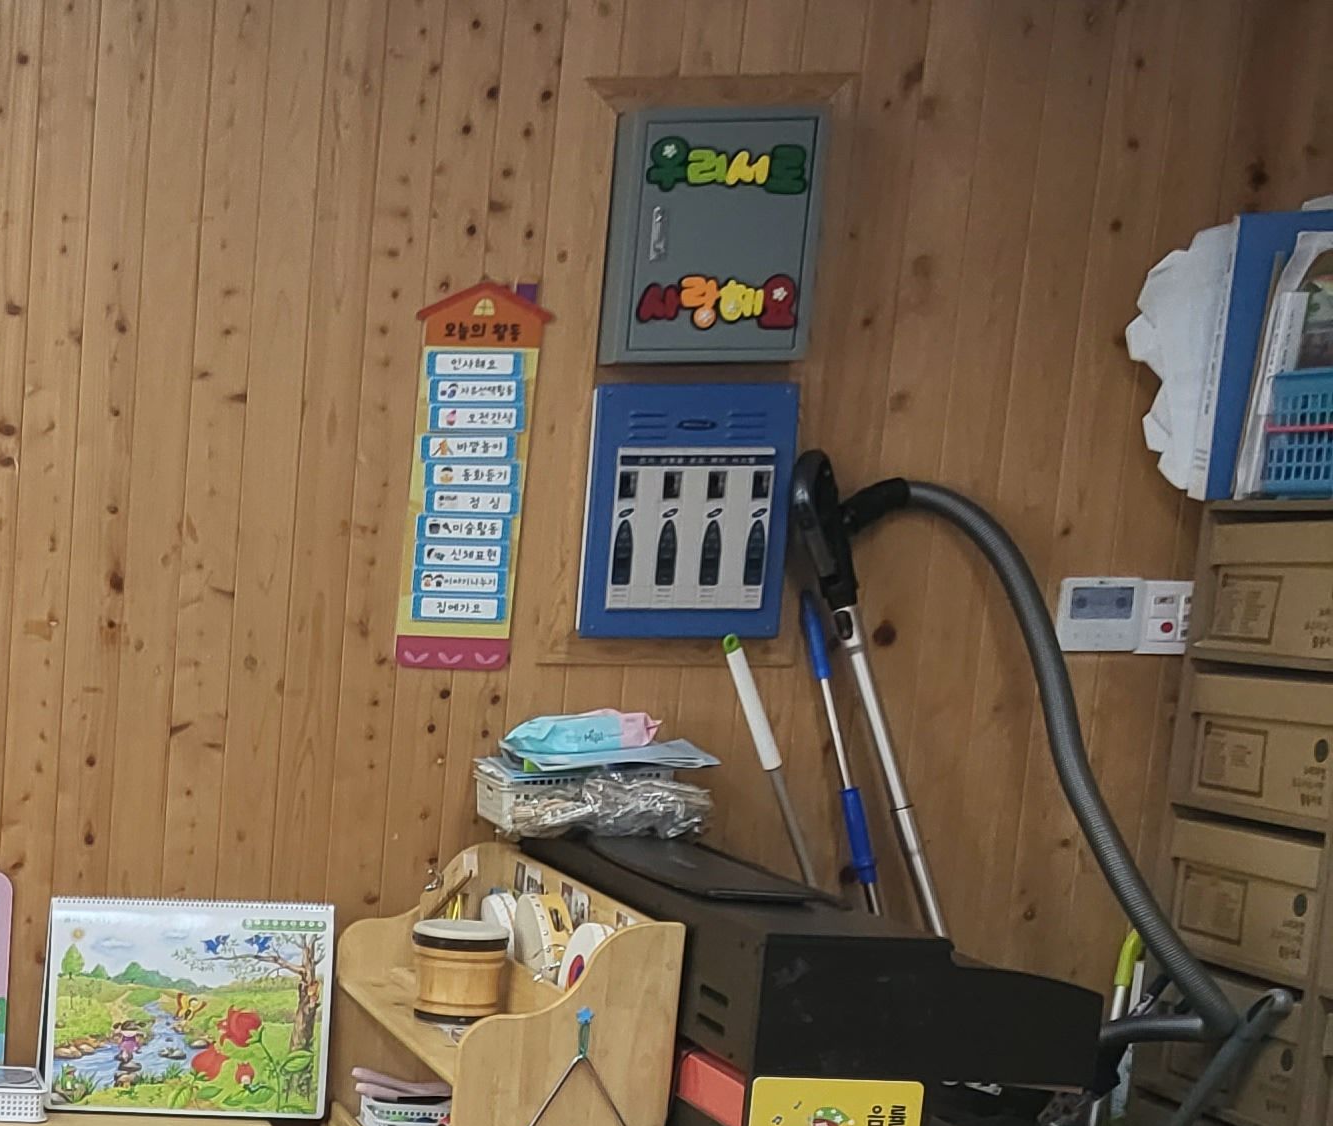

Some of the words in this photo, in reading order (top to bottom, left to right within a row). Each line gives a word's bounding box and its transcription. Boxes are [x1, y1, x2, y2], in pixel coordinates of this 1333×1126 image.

[647, 137, 808, 195] 우리서로
[636, 273, 798, 331] 사랑해요
[444, 322, 487, 340] 오늘의
[491, 322, 521, 342] 활동
[450, 358, 498, 371] 인사해요
[467, 411, 514, 425] 오전간식
[457, 440, 503, 453] 바깥놀이
[462, 467, 507, 481] 동화듣기
[452, 521, 499, 536] 미술활동
[450, 548, 497, 561] 신체표현
[437, 600, 482, 614] 집에가요
